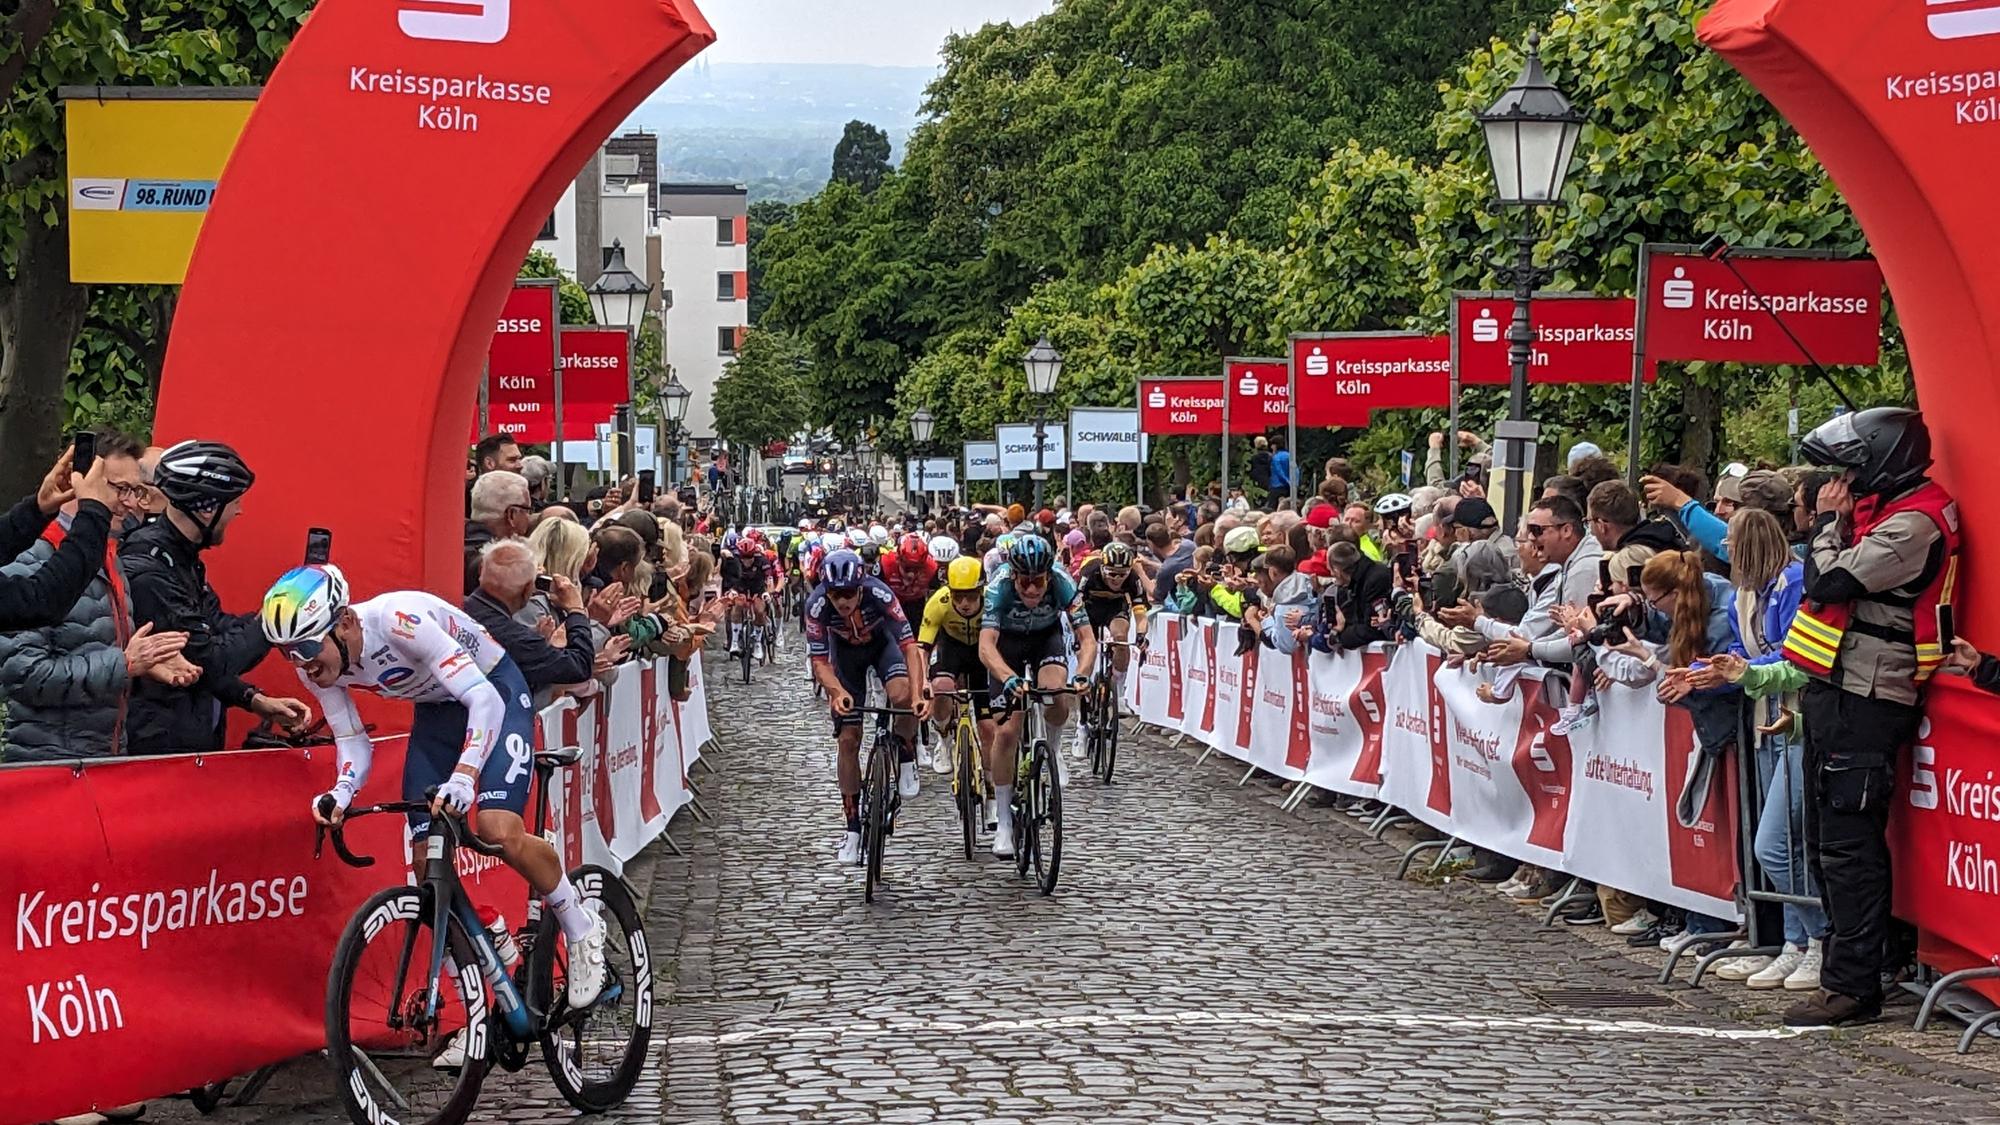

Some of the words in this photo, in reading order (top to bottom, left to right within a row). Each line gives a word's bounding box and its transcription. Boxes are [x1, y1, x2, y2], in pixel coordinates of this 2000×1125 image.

[350, 66, 551, 104] Kreissparkasse
[1886, 71, 2000, 100] Kreisspa
[418, 104, 479, 132] Köln
[1956, 96, 2000, 124] Köl
[1704, 289, 1868, 315] Kreissparkasse
[1704, 319, 1752, 341] Köln
[1335, 358, 1450, 375] Kreissparkasse
[500, 375, 536, 390] Köln
[1336, 379, 1371, 395] Köln
[1170, 411, 1198, 423] Köln
[1004, 442, 1056, 454] SCHWABE
[1947, 841, 1998, 894] Köln
[16, 868, 308, 951] Kreissparkasse
[26, 973, 124, 1044] Köln
